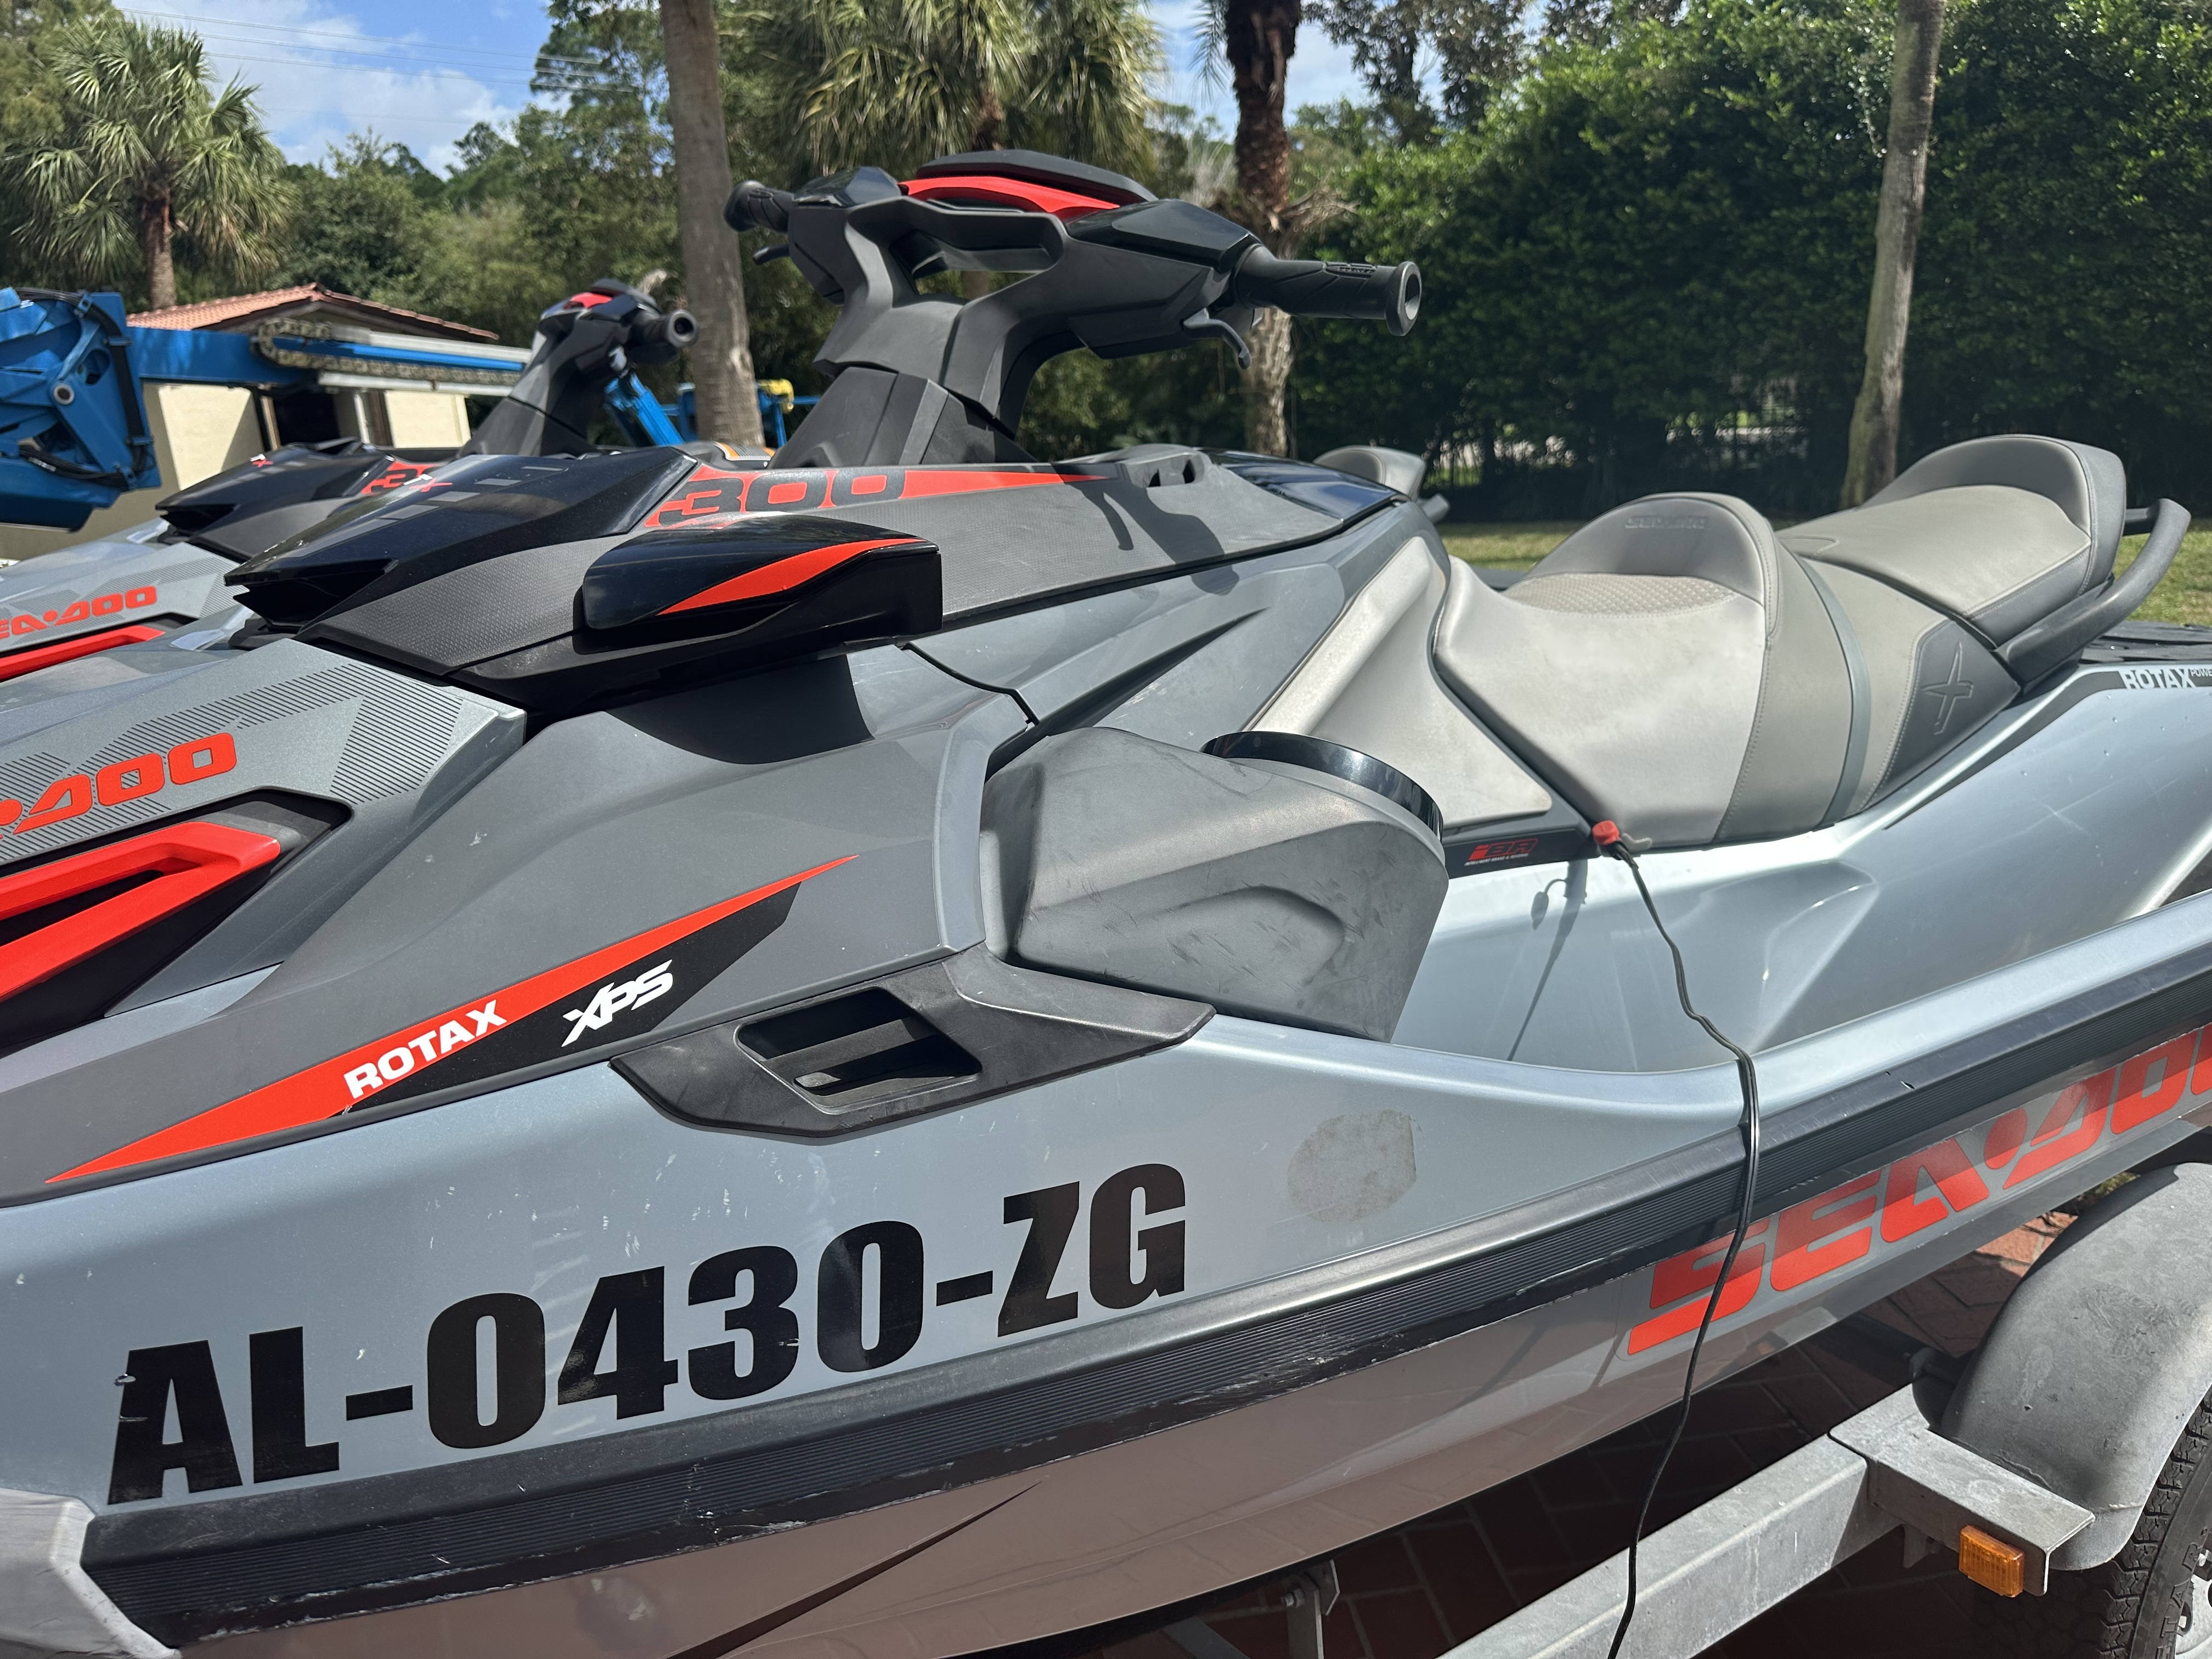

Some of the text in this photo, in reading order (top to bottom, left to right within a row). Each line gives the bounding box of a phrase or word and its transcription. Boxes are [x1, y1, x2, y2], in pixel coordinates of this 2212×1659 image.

[658, 469, 906, 527] 300
[2118, 667, 2197, 690] ROTAX
[561, 959, 674, 1047] XPS
[343, 999, 508, 1099] ROTAX
[108, 1163, 1186, 1505] AL-0430-ZG
